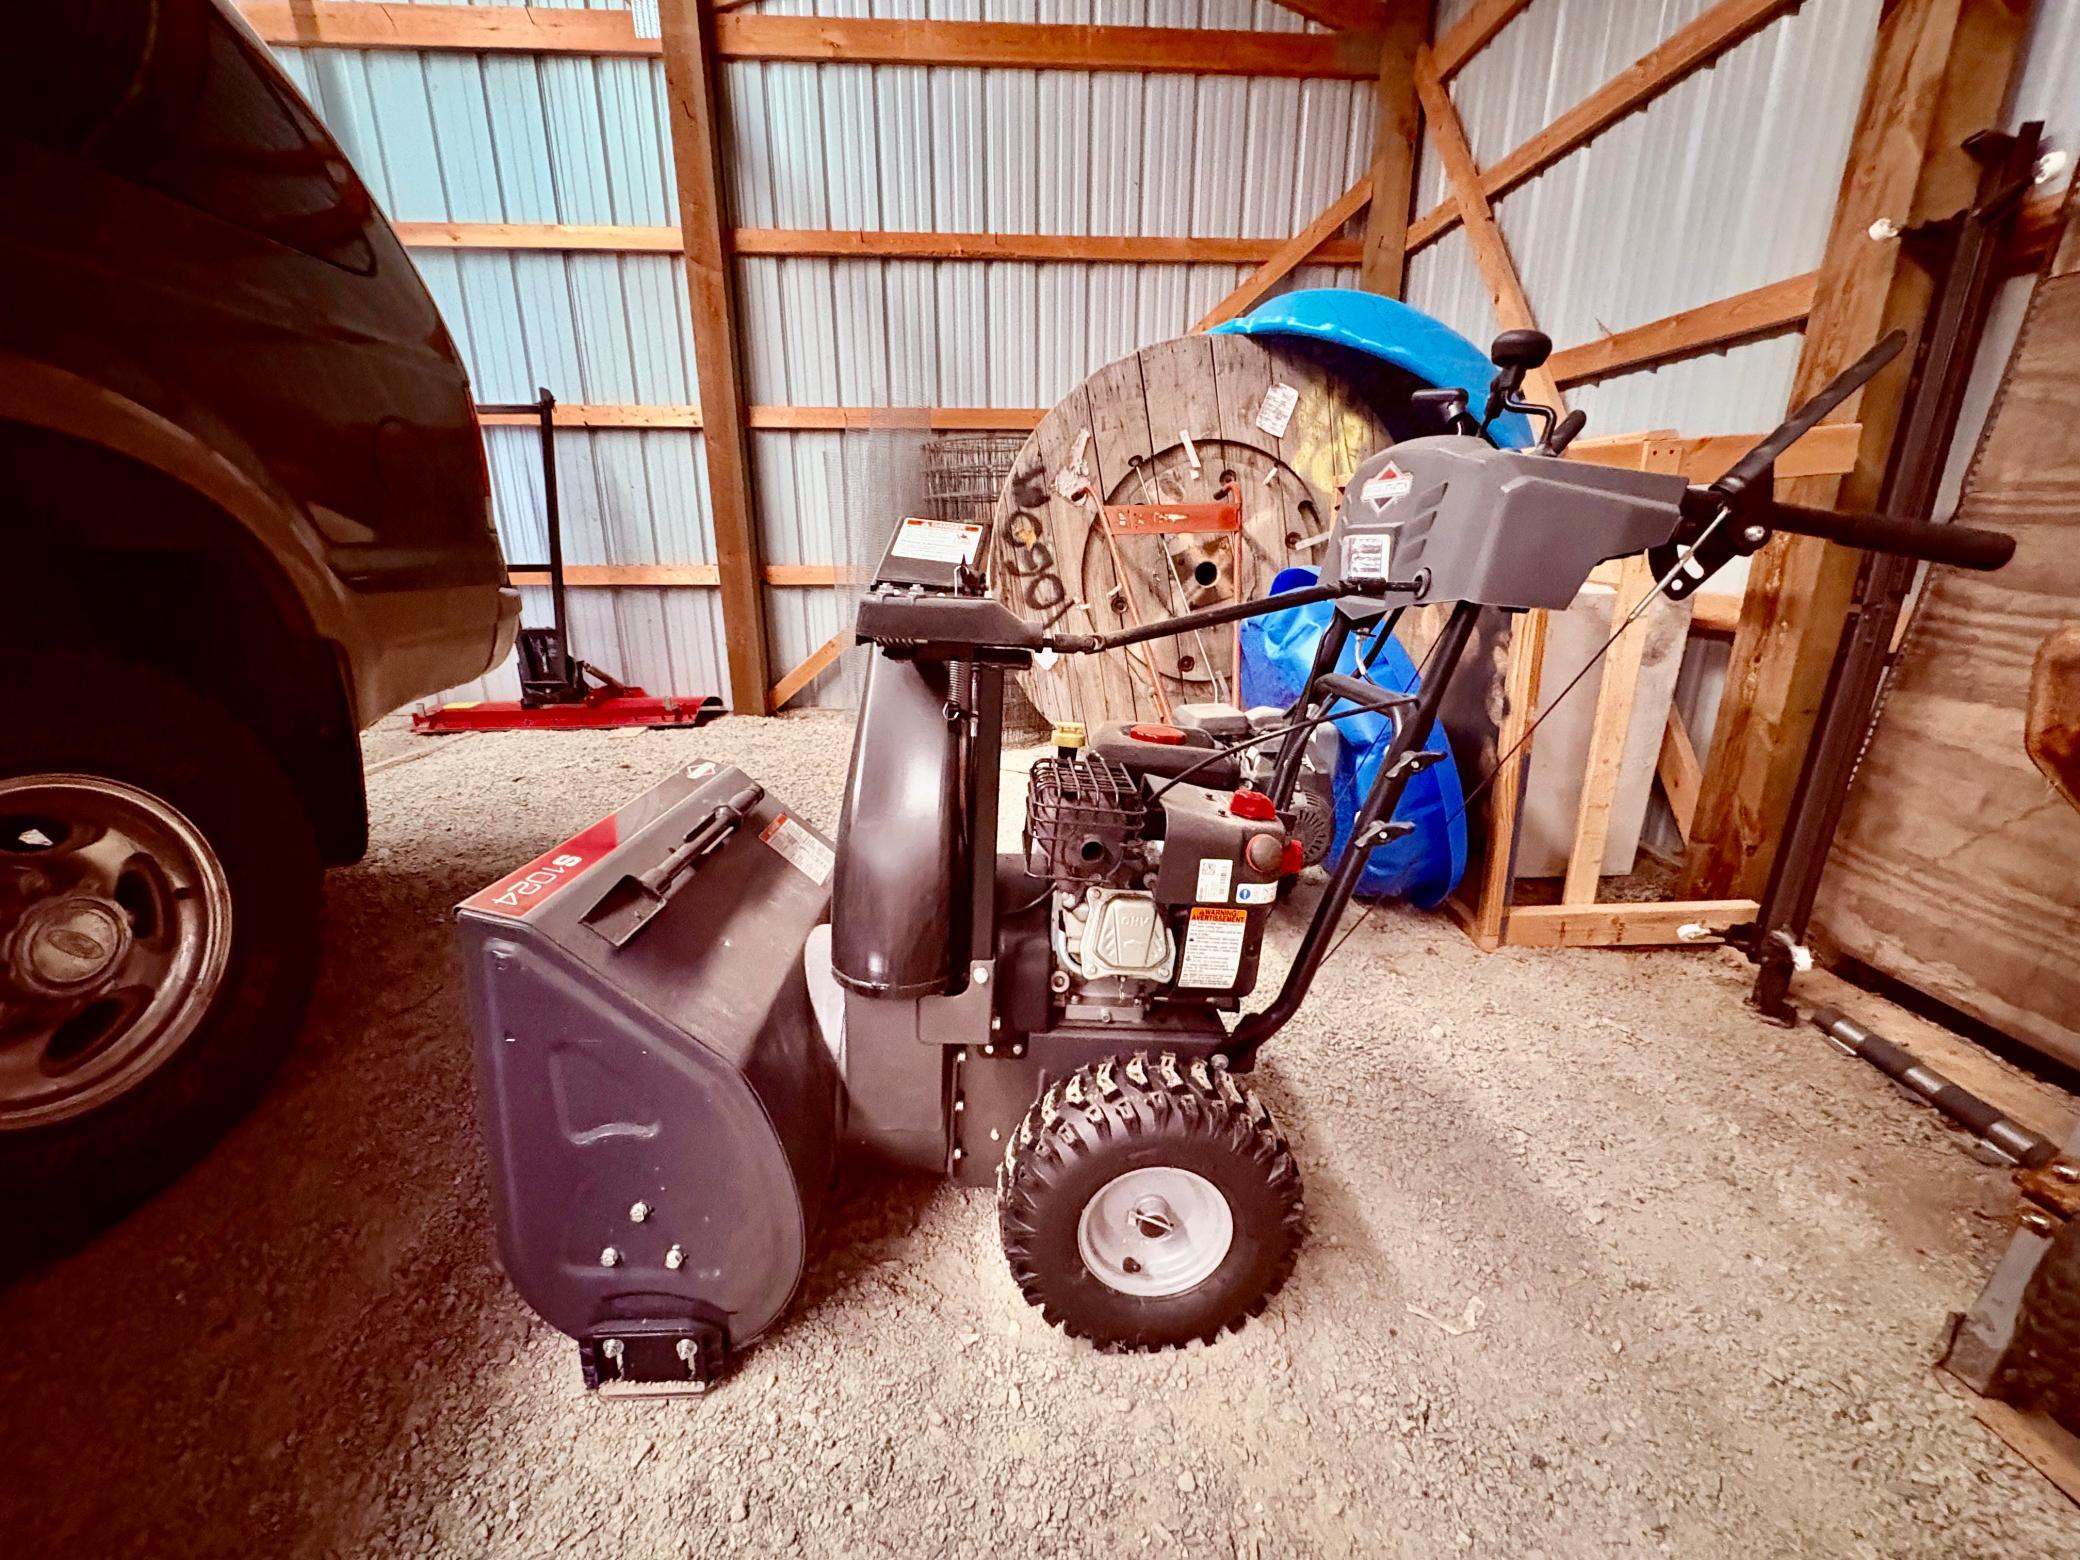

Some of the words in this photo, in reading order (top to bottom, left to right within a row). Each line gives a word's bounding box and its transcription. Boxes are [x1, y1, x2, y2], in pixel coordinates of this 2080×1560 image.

[492, 855, 583, 906] S1024
[1205, 908, 1237, 918] WARNING
[1191, 914, 1245, 923] AVERTISSEMENT
